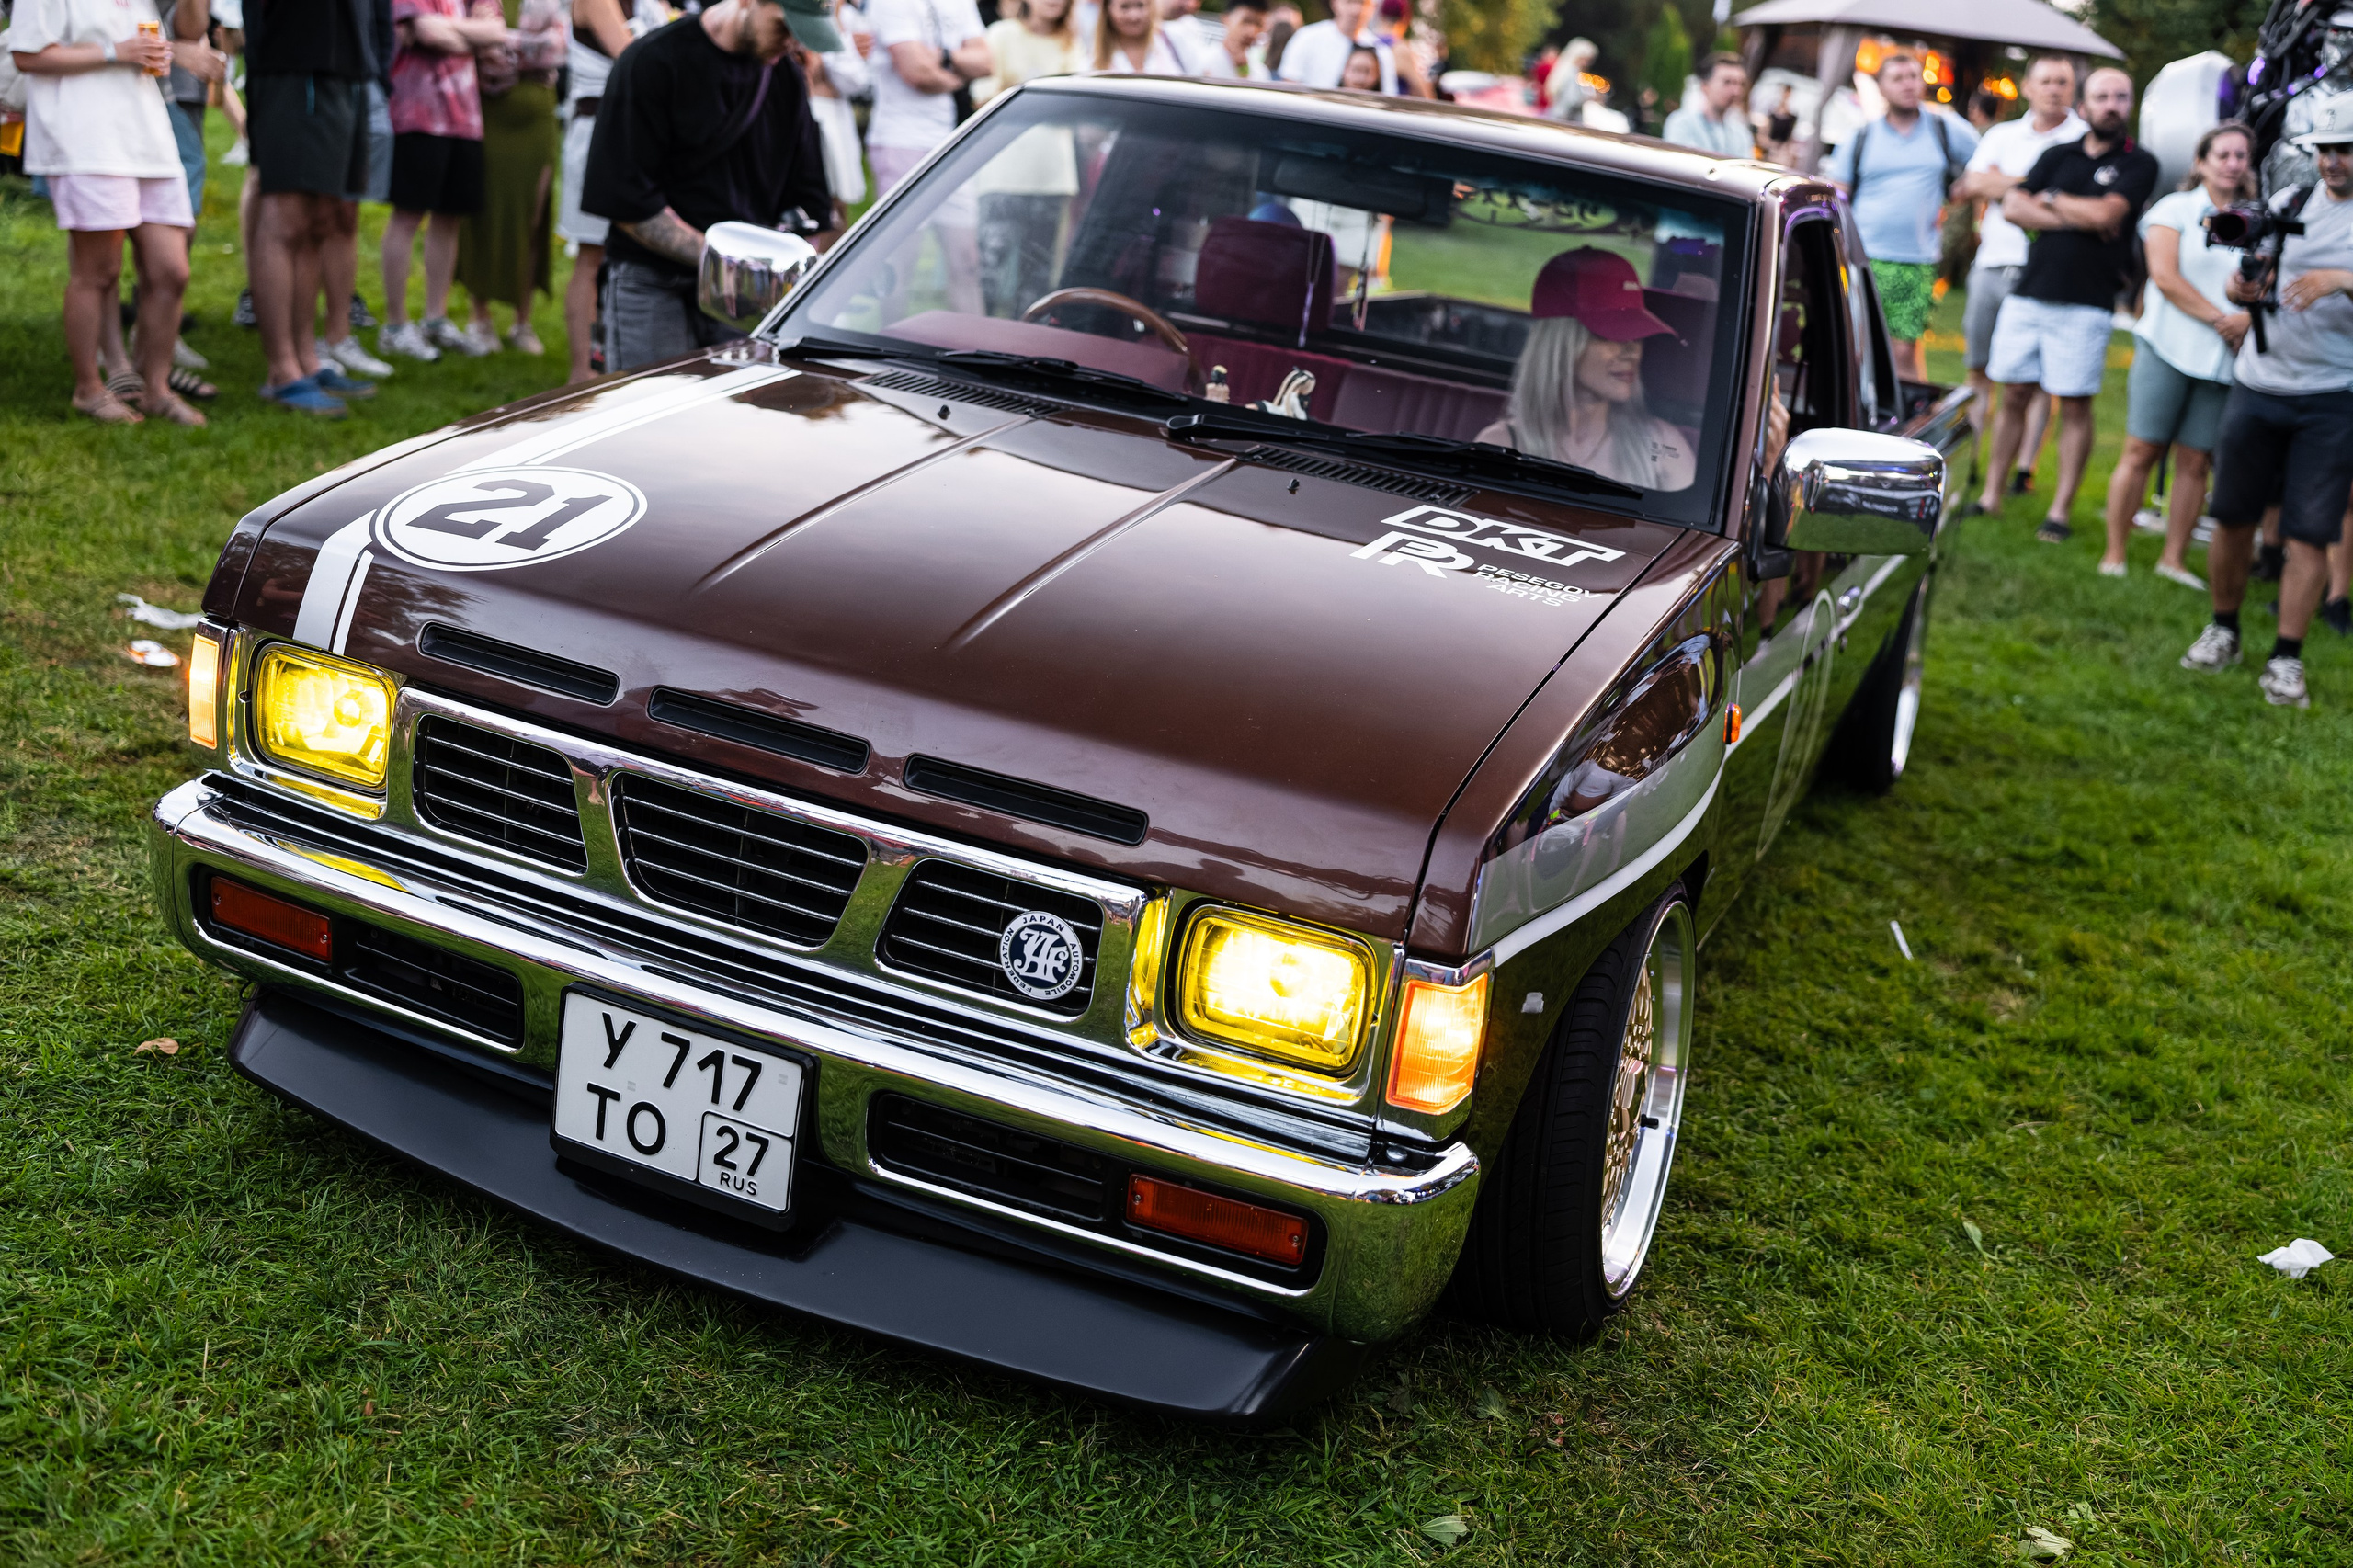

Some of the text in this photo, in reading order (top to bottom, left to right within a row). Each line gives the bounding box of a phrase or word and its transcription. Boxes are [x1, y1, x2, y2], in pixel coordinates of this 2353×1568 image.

[405, 479, 613, 551] 21
[1381, 505, 1626, 566] DKT
[1472, 571, 1581, 602] RACING
[1477, 564, 1602, 598] PESEGOV
[1486, 584, 1563, 607] ARTS
[1023, 915, 1064, 932] JAPAN
[1002, 927, 1032, 993] FEDERATION
[1044, 942, 1080, 996] AUTOMOBILE
[661, 1032, 762, 1111] 717
[713, 1125, 770, 1176] 27
[720, 1171, 757, 1196] RUS
